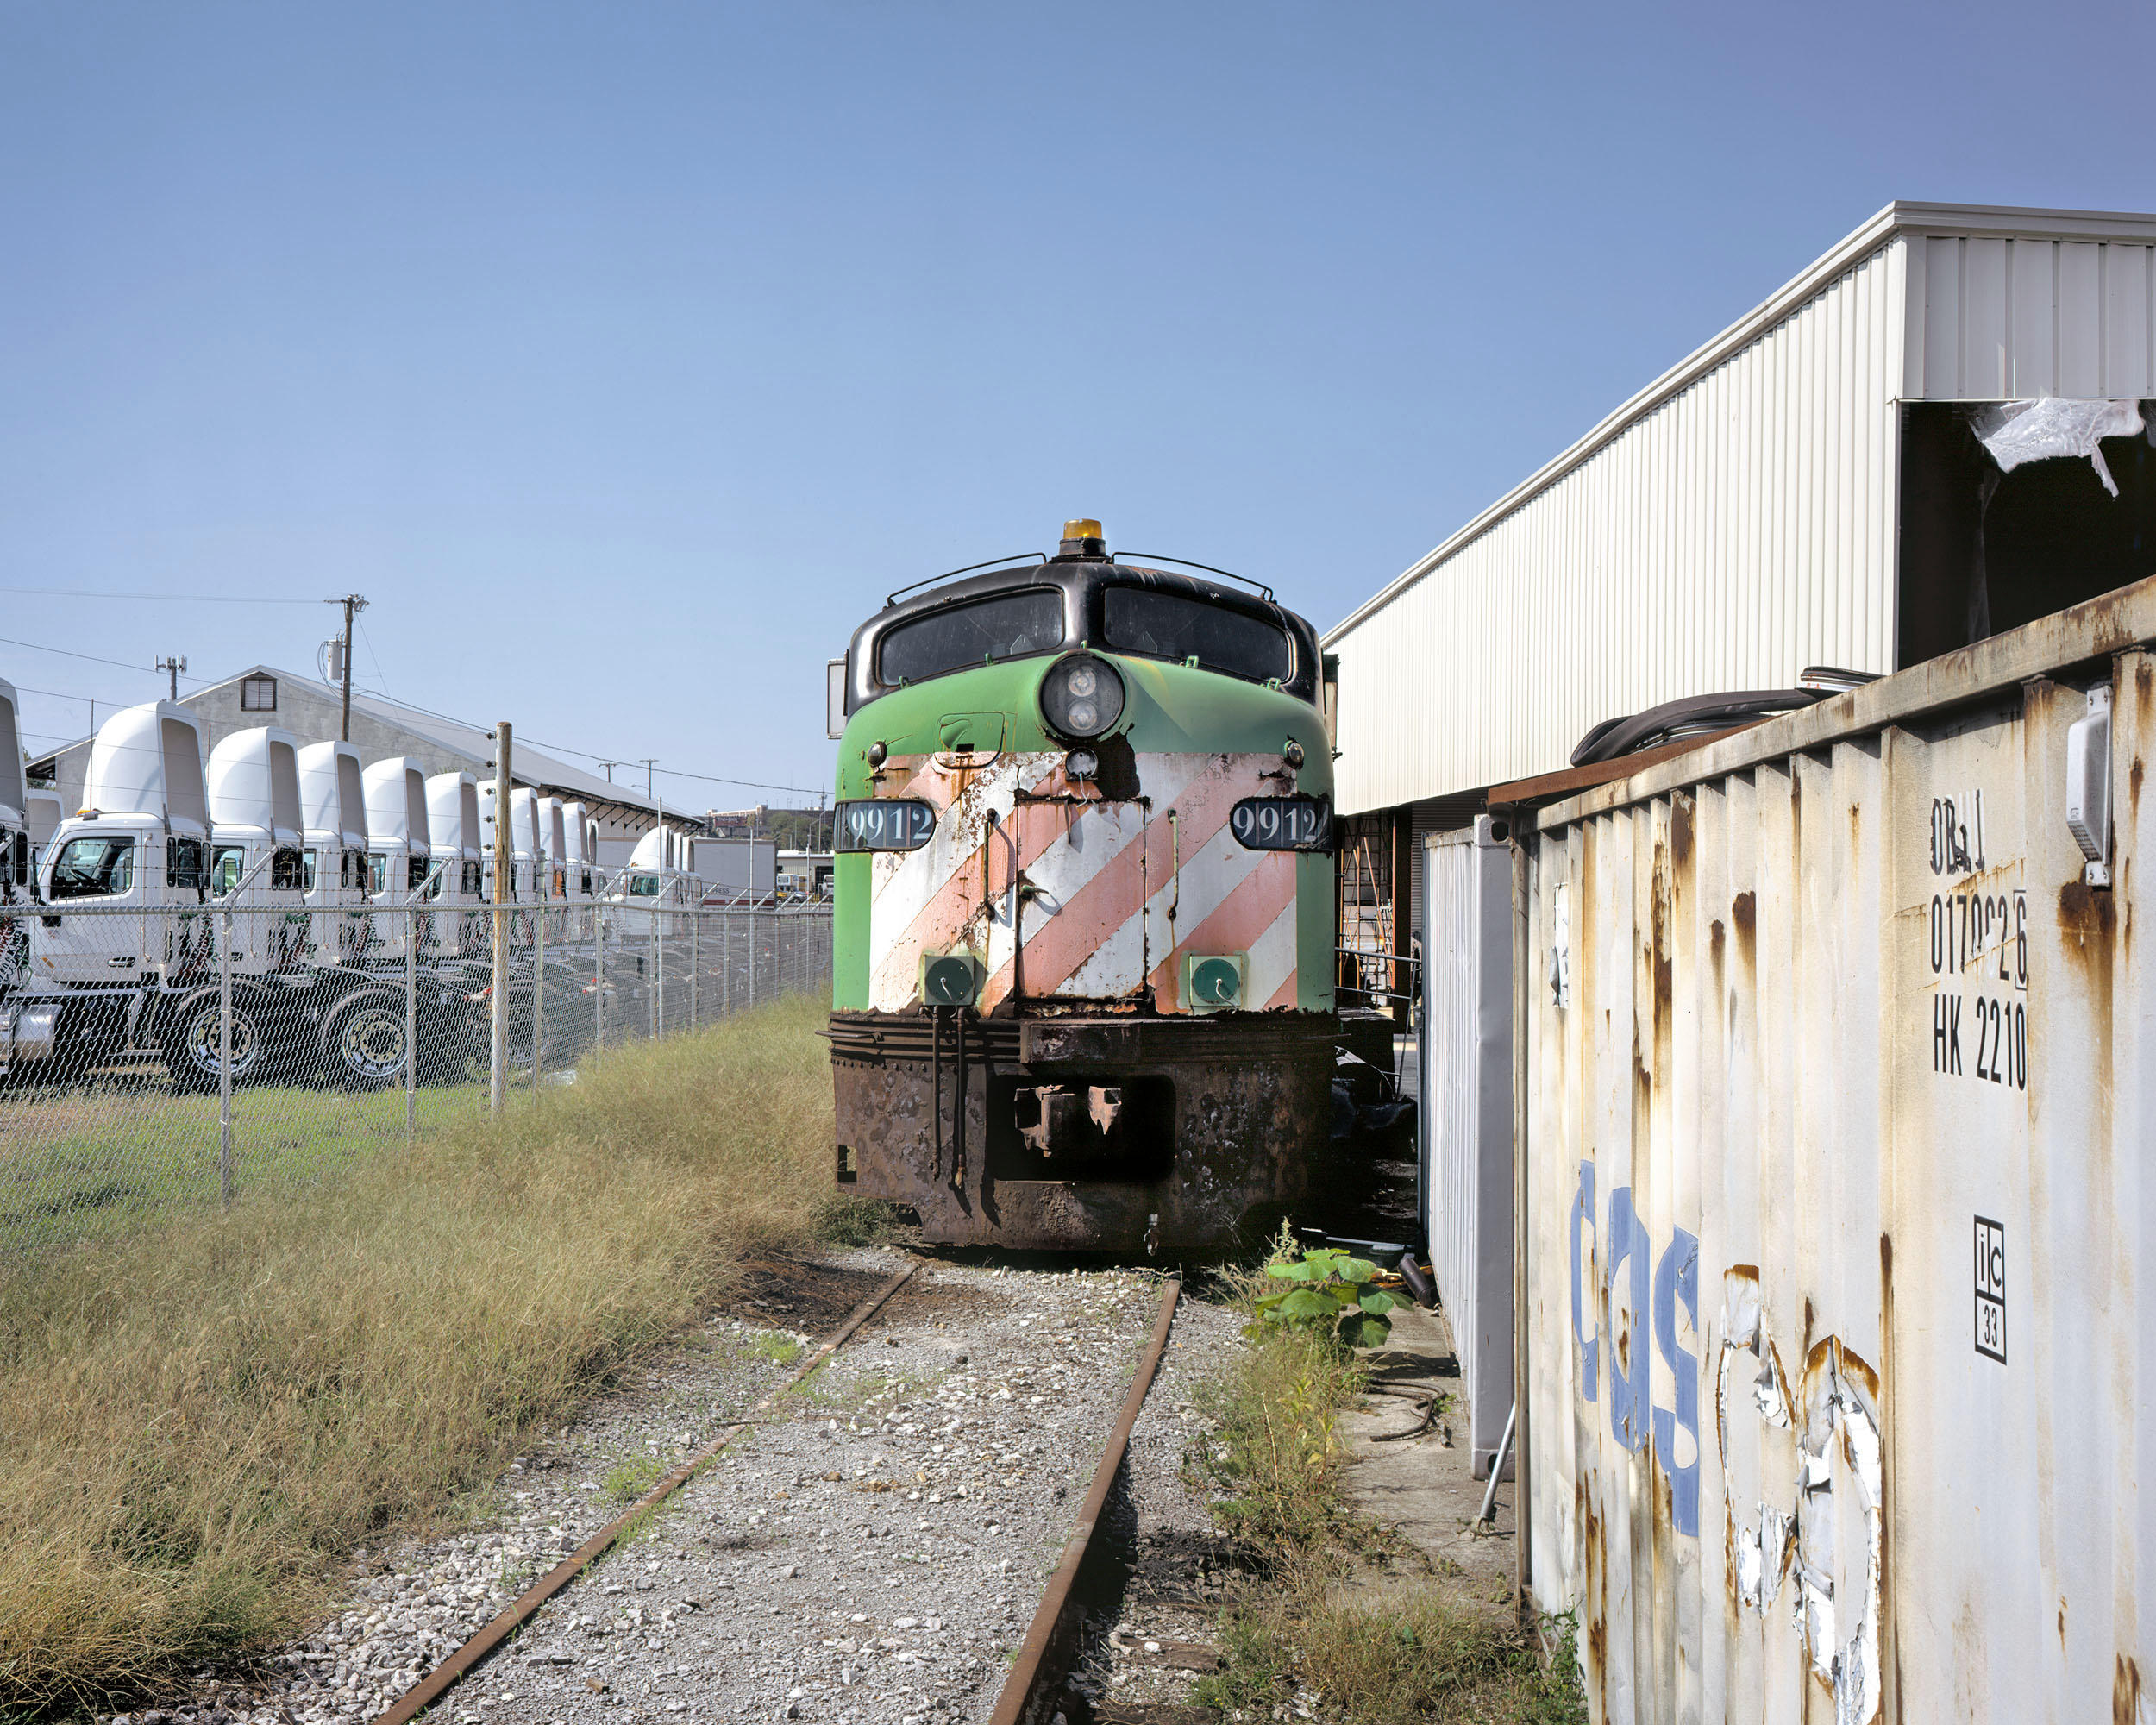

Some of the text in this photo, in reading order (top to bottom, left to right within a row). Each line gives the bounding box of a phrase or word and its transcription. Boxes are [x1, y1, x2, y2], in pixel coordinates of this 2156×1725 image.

[851, 807, 932, 842] 9912
[1232, 806, 1317, 842] 9912
[1934, 994, 2026, 1091] HK 2210
[1984, 1304, 1998, 1348] 33
